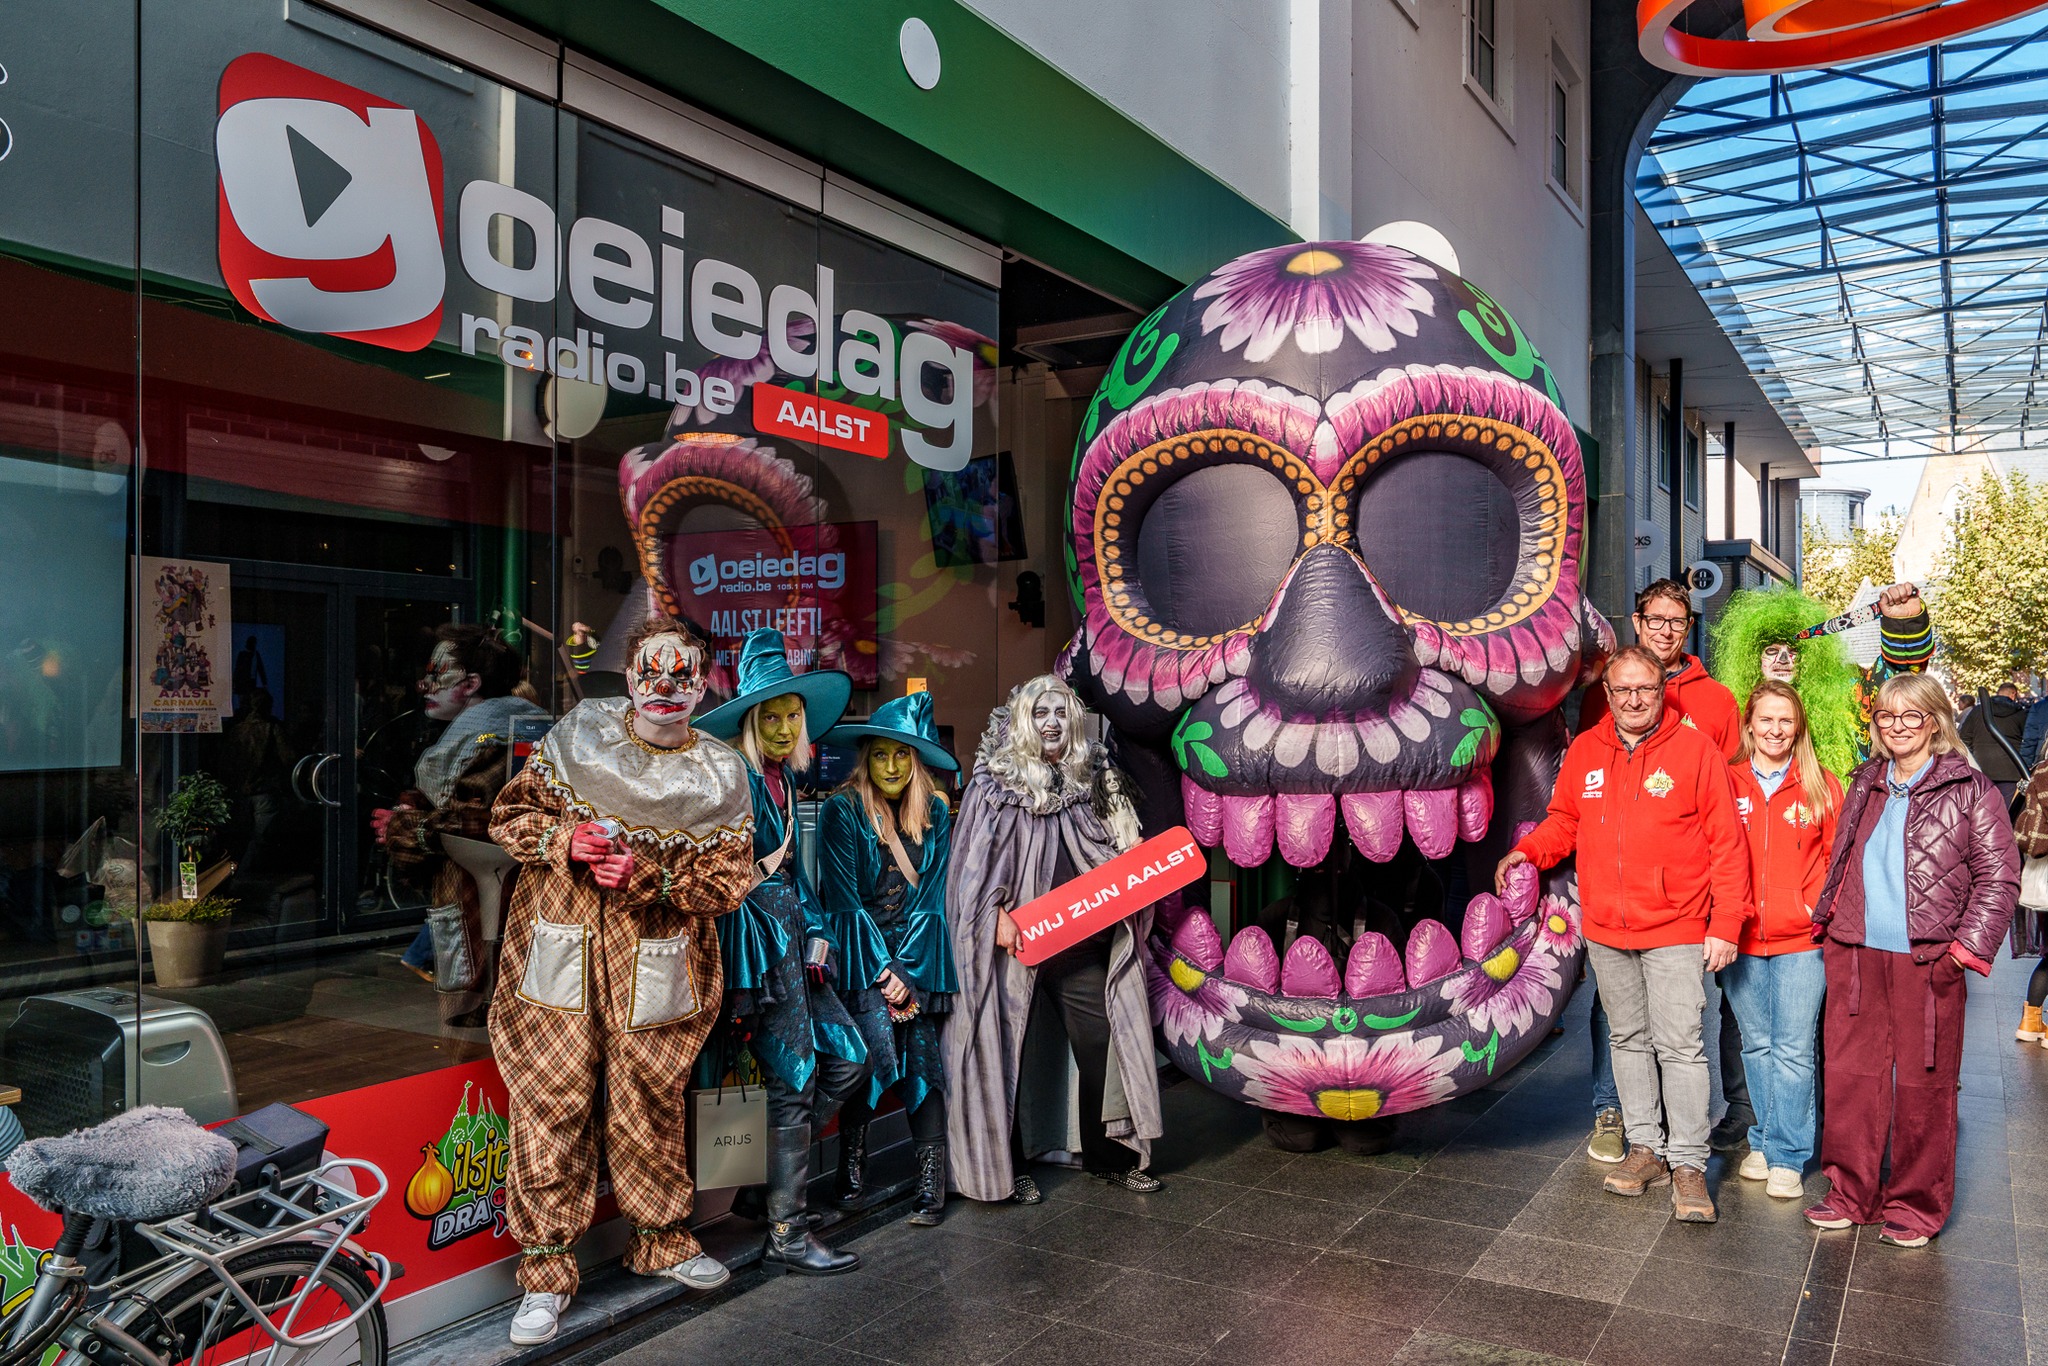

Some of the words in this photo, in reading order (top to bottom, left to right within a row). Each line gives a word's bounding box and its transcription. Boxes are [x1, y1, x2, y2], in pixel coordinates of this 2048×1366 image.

[461, 312, 735, 415] radio.be
[777, 400, 871, 442] AALST
[689, 550, 845, 596] goeiedag
[720, 581, 772, 594] radio.be
[777, 583, 799, 591] 105.1
[711, 609, 762, 638] AALST
[716, 650, 735, 666] MET
[158, 689, 210, 698] AALST
[1022, 912, 1065, 942] WIJ
[1067, 883, 1121, 920] ZIJN
[1126, 842, 1195, 891] AALST
[713, 1133, 752, 1147] ARIJS
